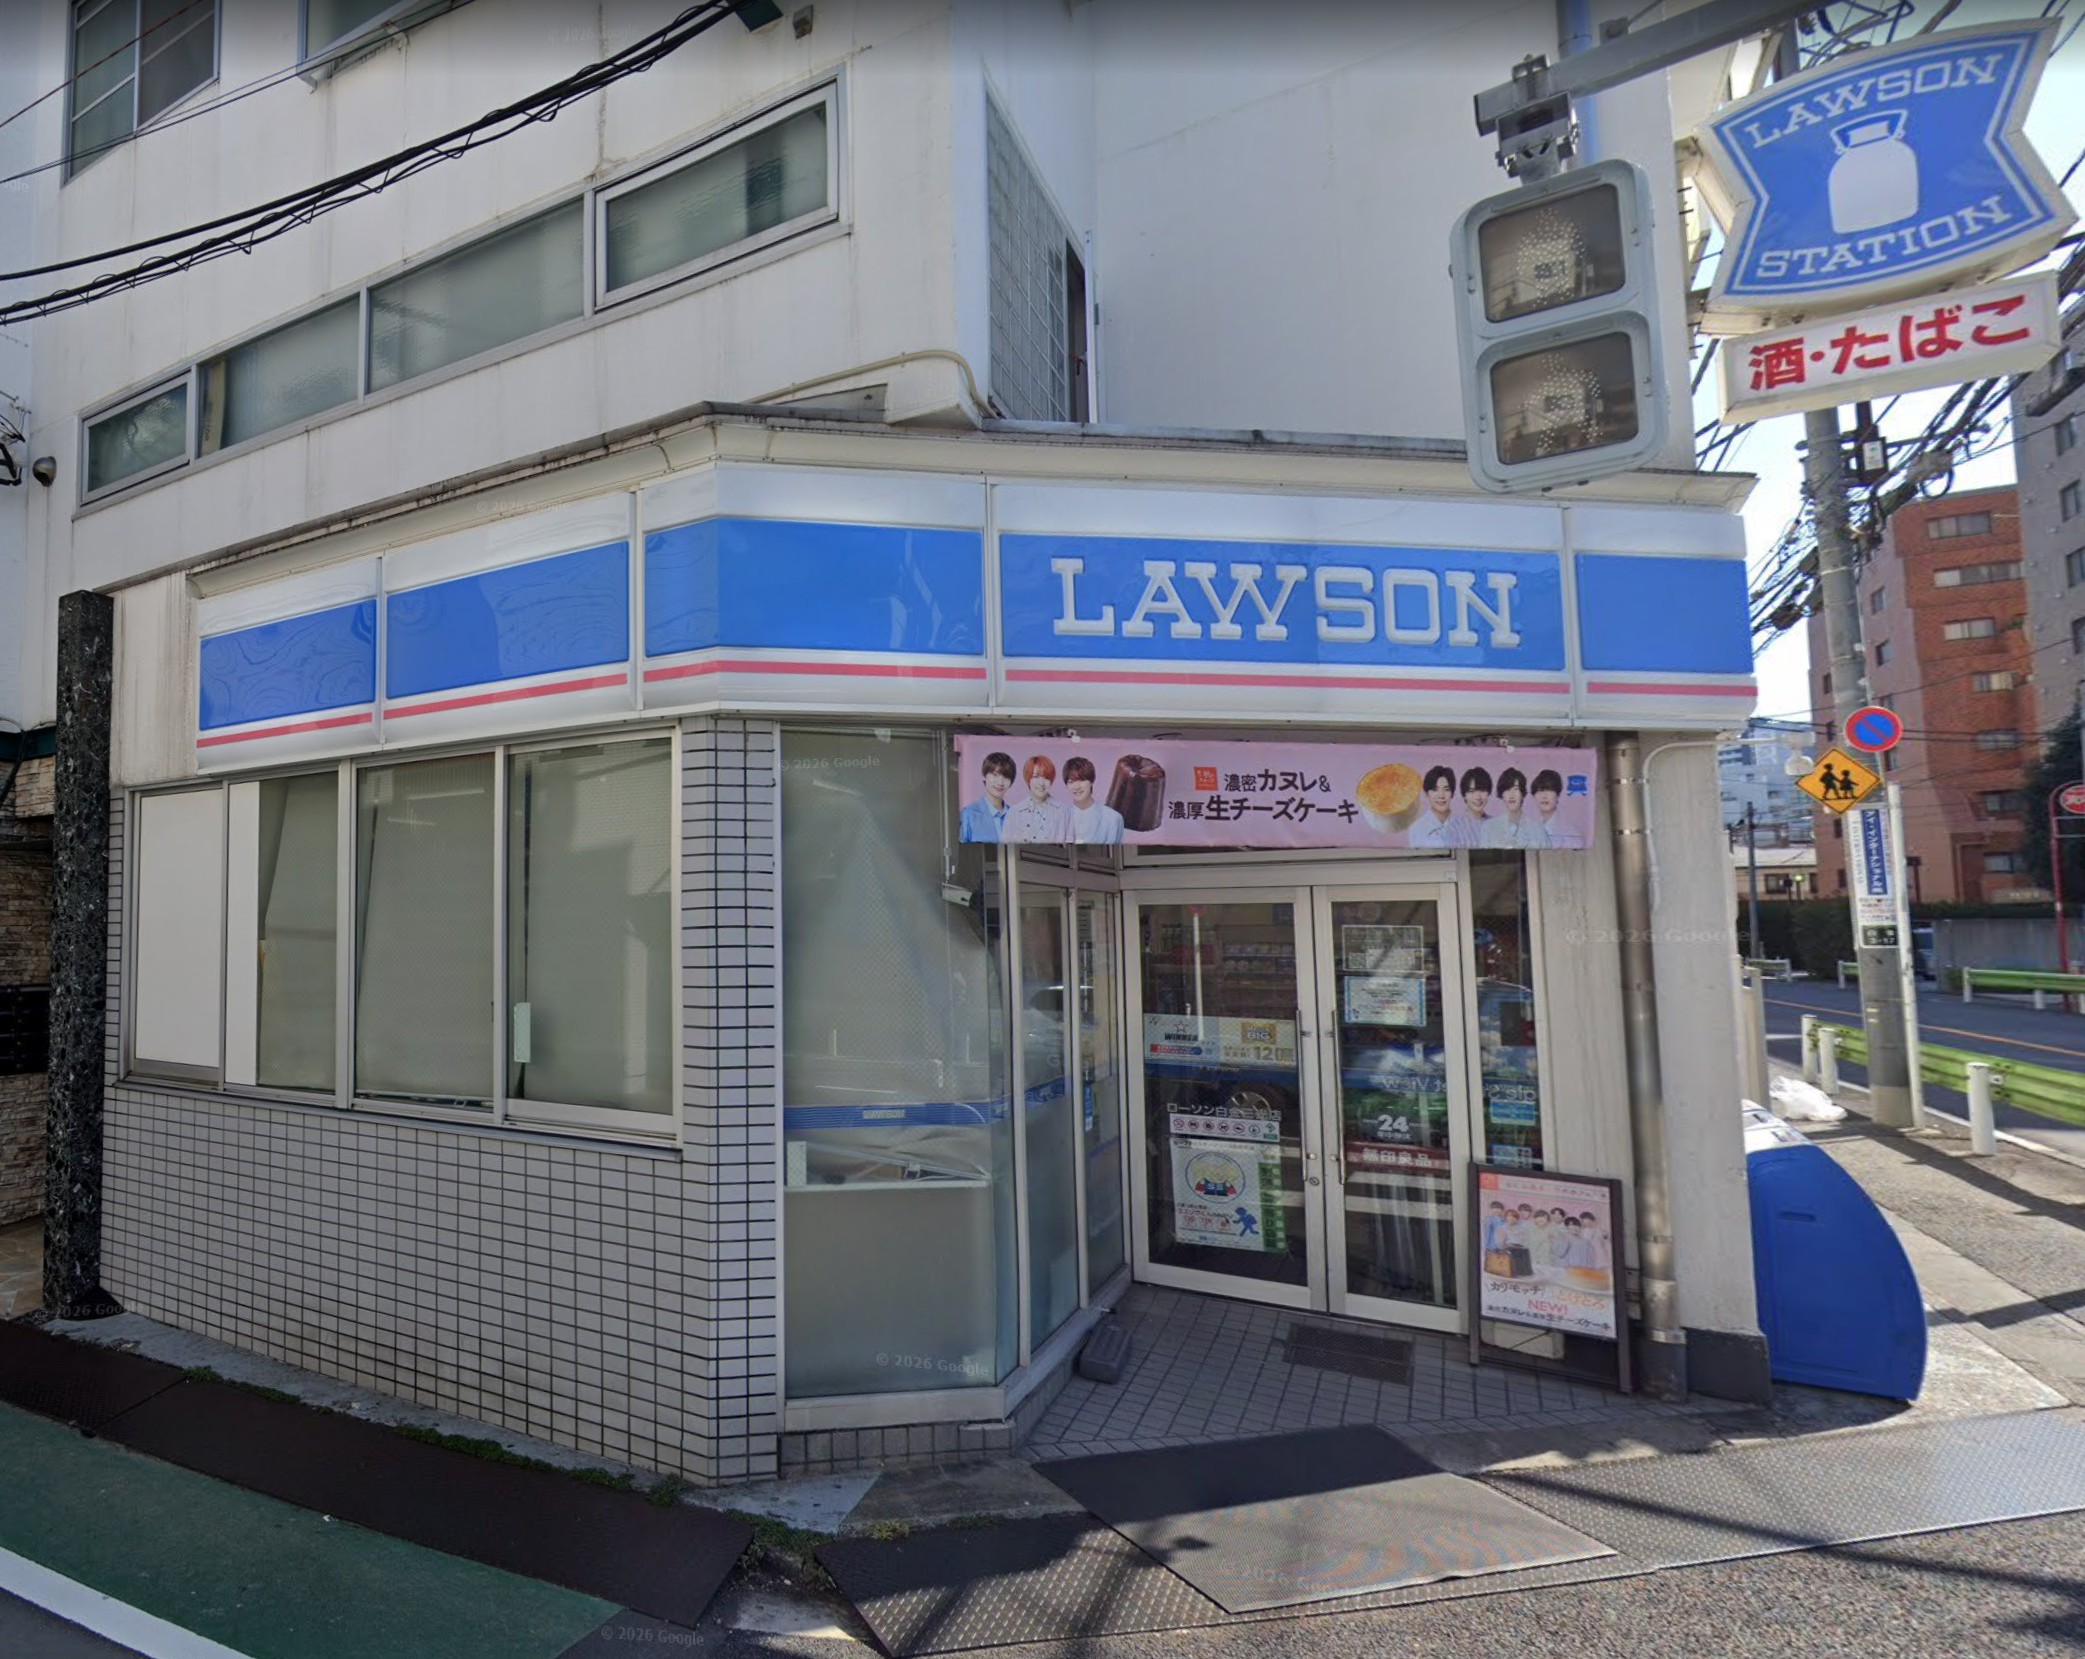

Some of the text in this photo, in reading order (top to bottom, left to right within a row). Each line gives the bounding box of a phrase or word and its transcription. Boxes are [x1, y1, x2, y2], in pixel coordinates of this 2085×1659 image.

[1744, 54, 2004, 149] LAWSON
[1756, 194, 2013, 279] STATION
[1050, 557, 1522, 649] LAWSON
[1224, 768, 1331, 793] 濃密カヌレ&
[1169, 795, 1359, 824] 濃厚生チーズケーキ
[1377, 1114, 1409, 1132] 24
[1362, 1147, 1432, 1167] 無印良品
[1527, 1299, 1568, 1316] NEW!
